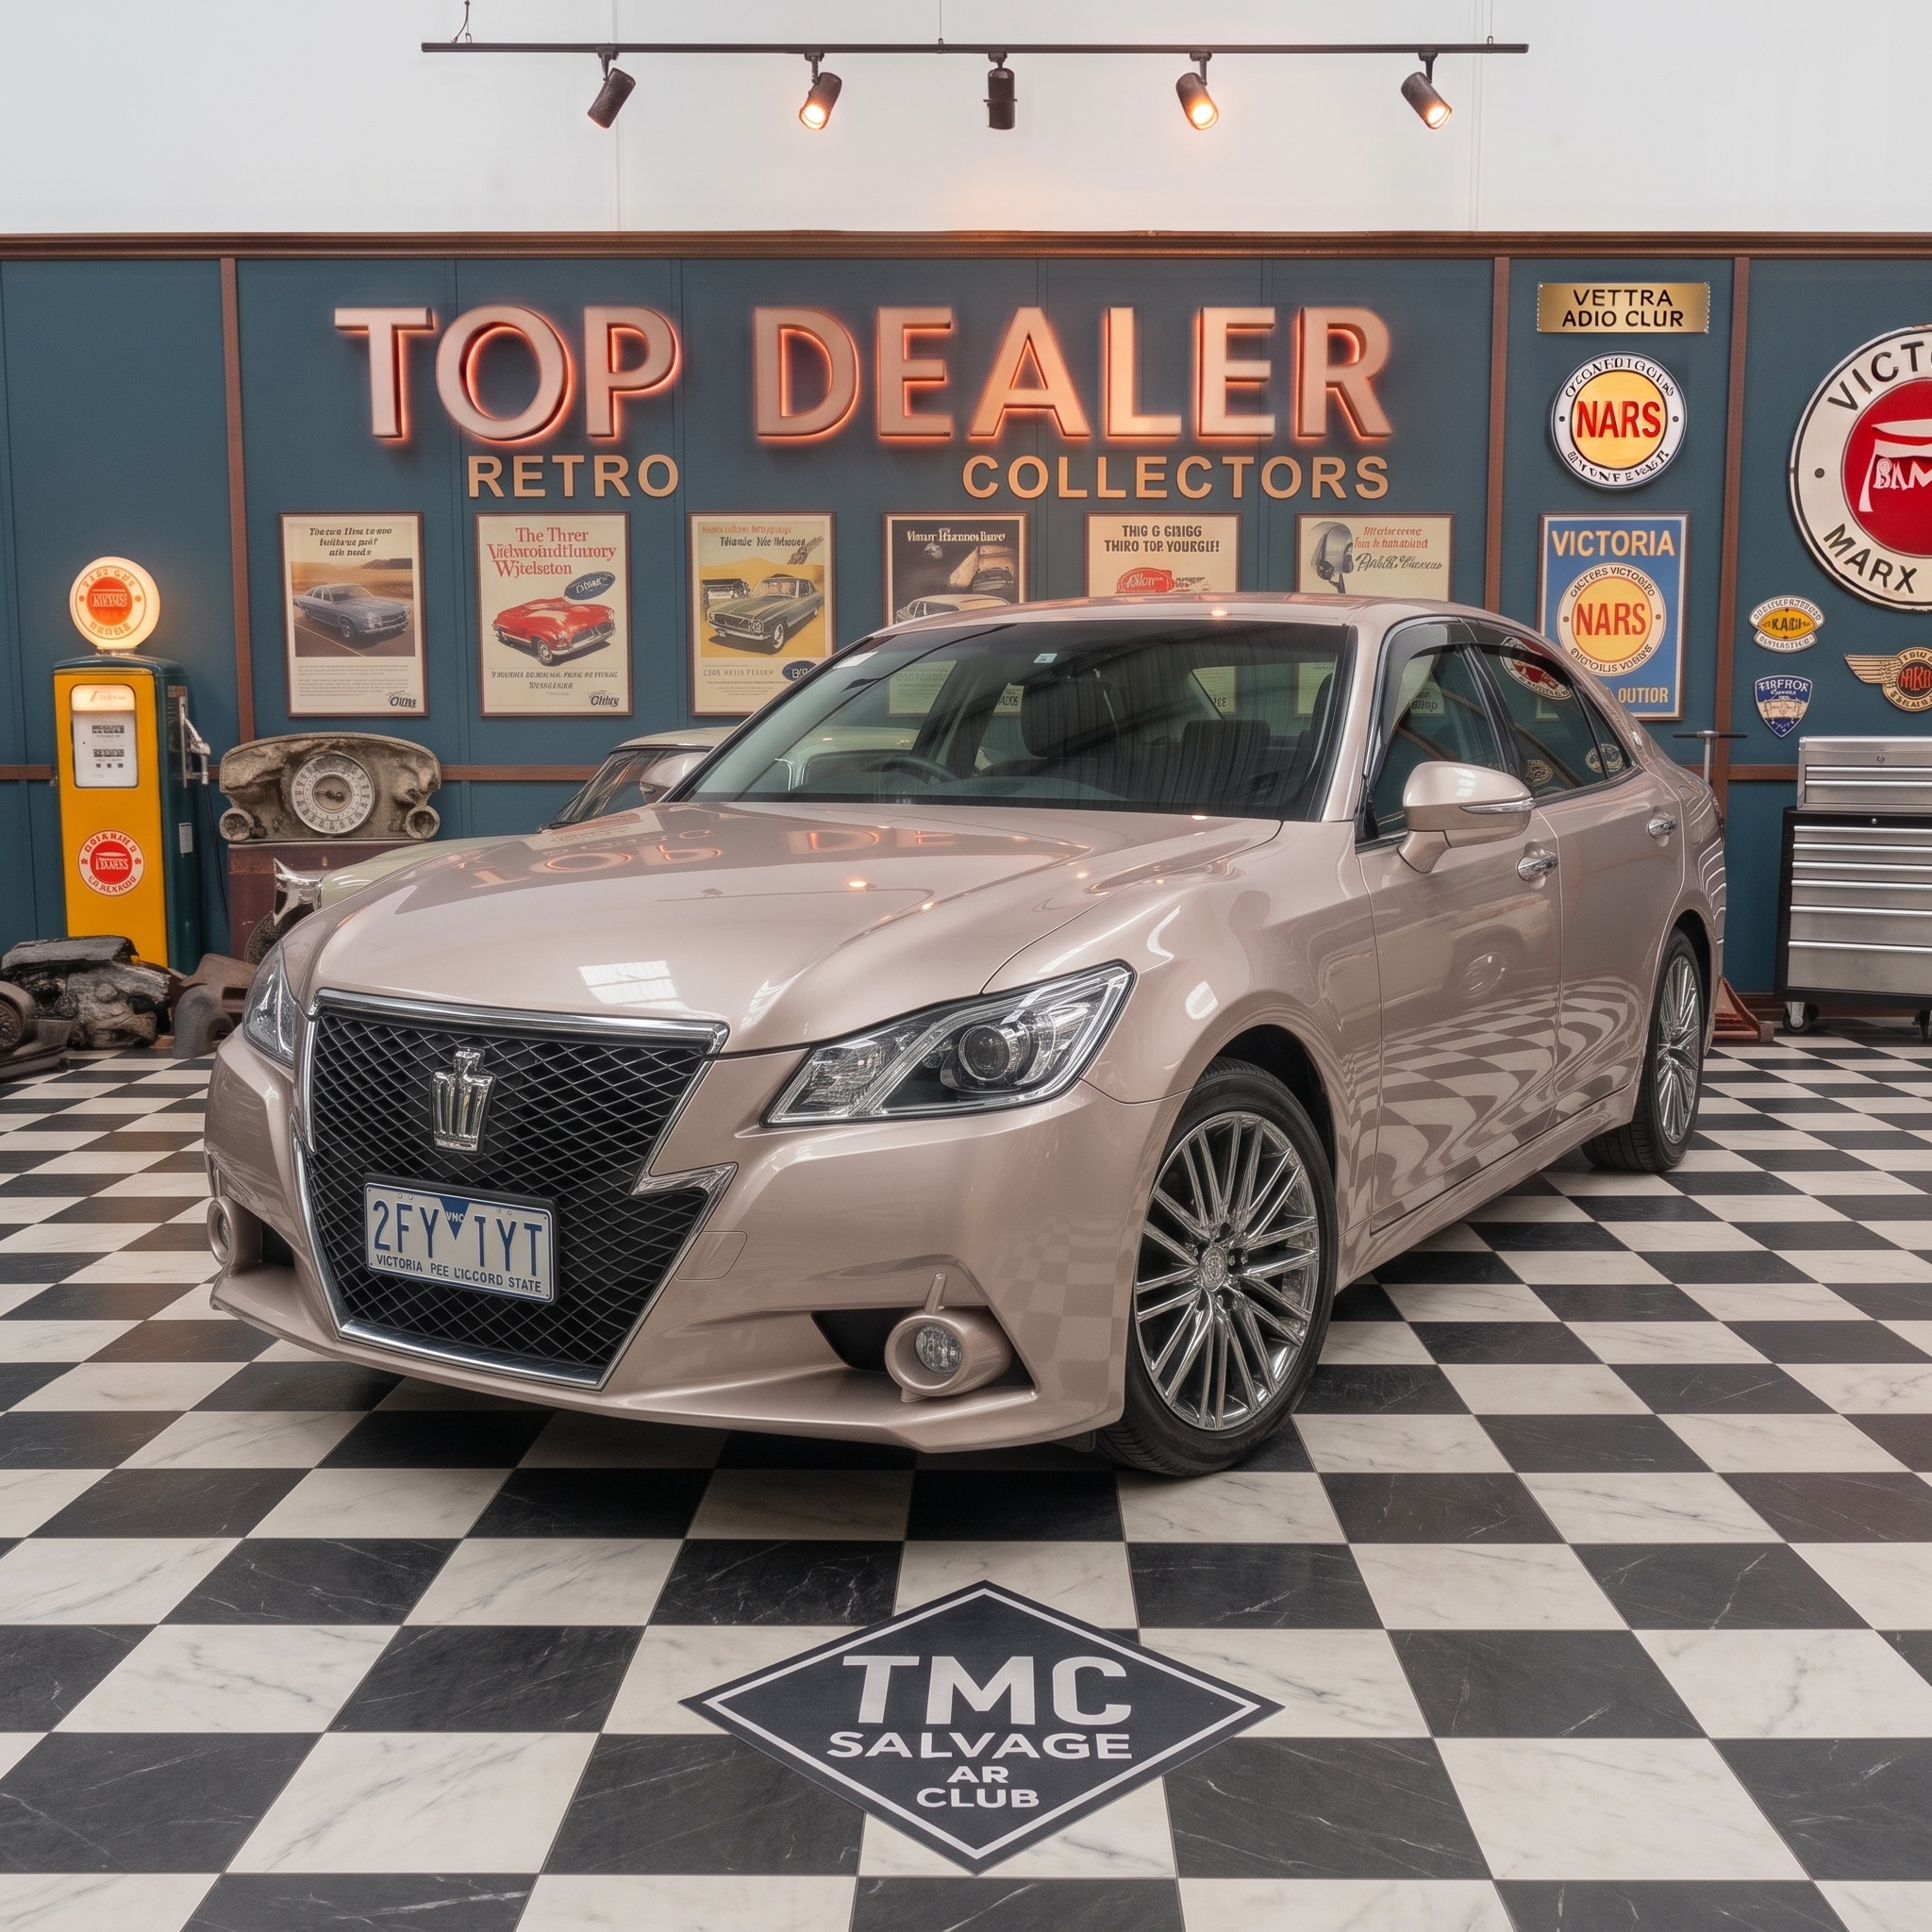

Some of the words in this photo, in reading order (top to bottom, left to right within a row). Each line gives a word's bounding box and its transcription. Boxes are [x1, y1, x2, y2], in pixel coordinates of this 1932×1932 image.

[1574, 290, 1674, 307] VETTRA
[1562, 310, 1617, 327] ADIO
[1625, 310, 1684, 327] CLUR
[334, 305, 680, 441] TOP
[755, 306, 1393, 439] DEALER
[1826, 341, 1932, 411] VICT
[1576, 400, 1661, 439] NARS
[467, 454, 679, 498] RETRO
[962, 455, 1391, 499] COLLECTORS
[515, 527, 544, 542] The
[1151, 525, 1161, 537] G
[1551, 530, 1675, 557] VICTORIA
[1823, 523, 1918, 594] MARX
[1575, 603, 1647, 636] NARS
[373, 1199, 440, 1258] 2FY
[376, 1254, 424, 1273] VICTORIA
[430, 1262, 450, 1277] PEE
[508, 1276, 541, 1293] STATE
[842, 1655, 1133, 1726] TMC
[825, 1731, 1133, 1760] SALVAGE
[946, 1765, 1010, 1784] AR
[915, 1787, 1040, 1809] CLUB
